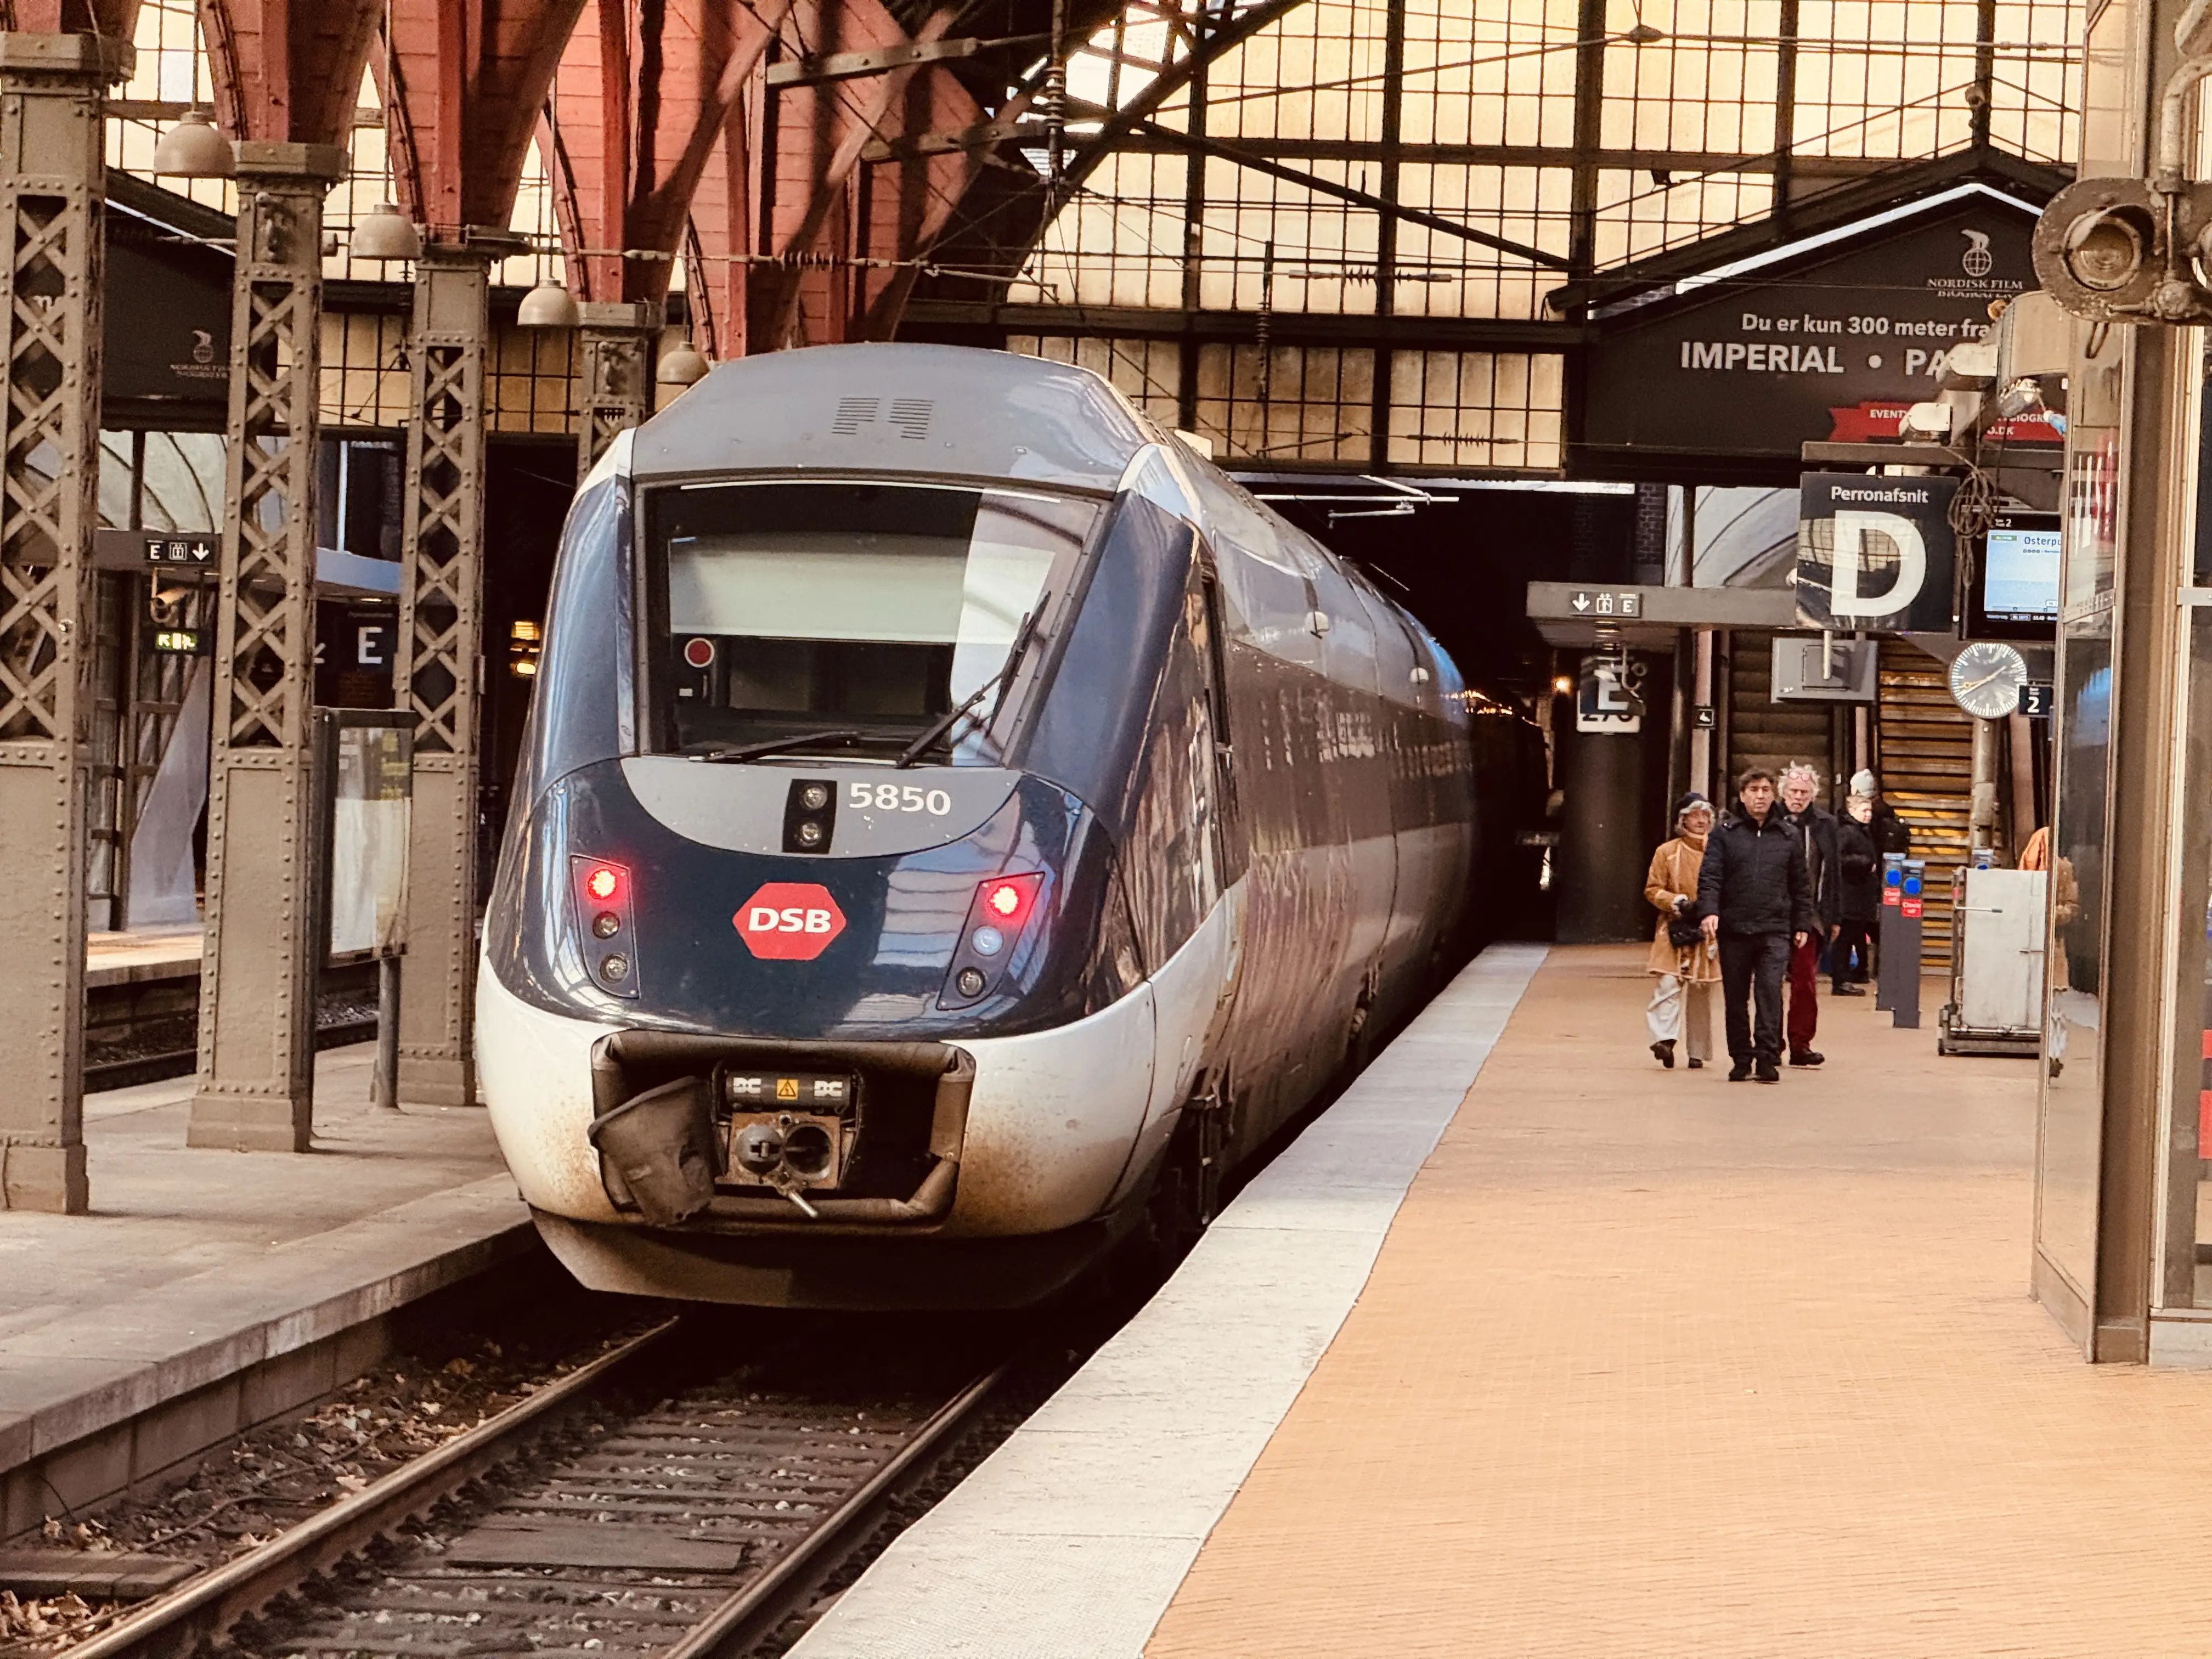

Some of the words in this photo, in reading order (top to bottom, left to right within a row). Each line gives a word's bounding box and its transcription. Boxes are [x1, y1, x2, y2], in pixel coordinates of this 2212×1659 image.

[1927, 278, 1987, 288] NORDISK
[1991, 280, 2023, 290] FILM
[1741, 313, 1771, 331] Du
[1776, 319, 1800, 332] er
[1804, 314, 1842, 334] kun
[1847, 317, 1889, 335] 300
[1894, 319, 1958, 337] meter
[1680, 341, 1846, 374] IMPERIAL
[1831, 486, 1929, 503] Perronafsnit
[2006, 518, 2012, 527] 2
[150, 545, 161, 560] E
[1831, 510, 1926, 617] D
[1622, 600, 1633, 613] E
[358, 627, 382, 664] E
[2027, 696, 2040, 713] 2
[849, 783, 952, 816] 5850
[748, 907, 832, 933] DSB
